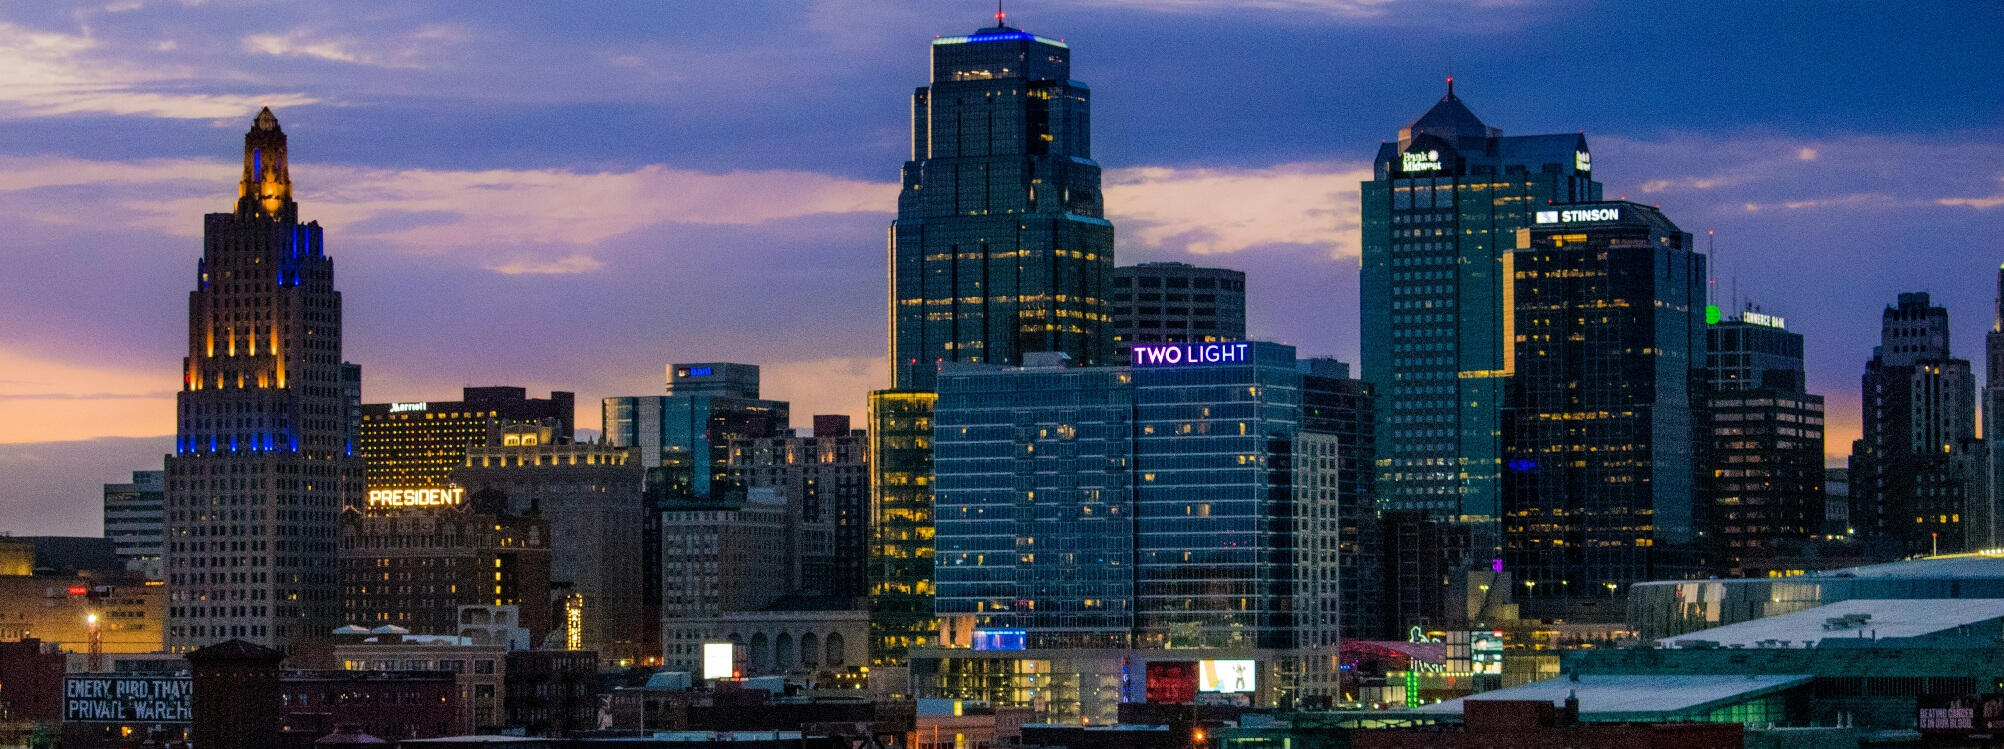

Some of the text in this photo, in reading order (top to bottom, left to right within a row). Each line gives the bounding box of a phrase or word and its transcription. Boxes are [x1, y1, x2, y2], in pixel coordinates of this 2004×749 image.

[1403, 151, 1427, 161] Bank
[1403, 161, 1442, 172] Midwest
[1562, 208, 1619, 222] STINSON
[1743, 311, 1785, 329] COMMERCE BANK
[1134, 344, 1248, 364] TWO LIGHT
[368, 488, 464, 506] PRESIDENT
